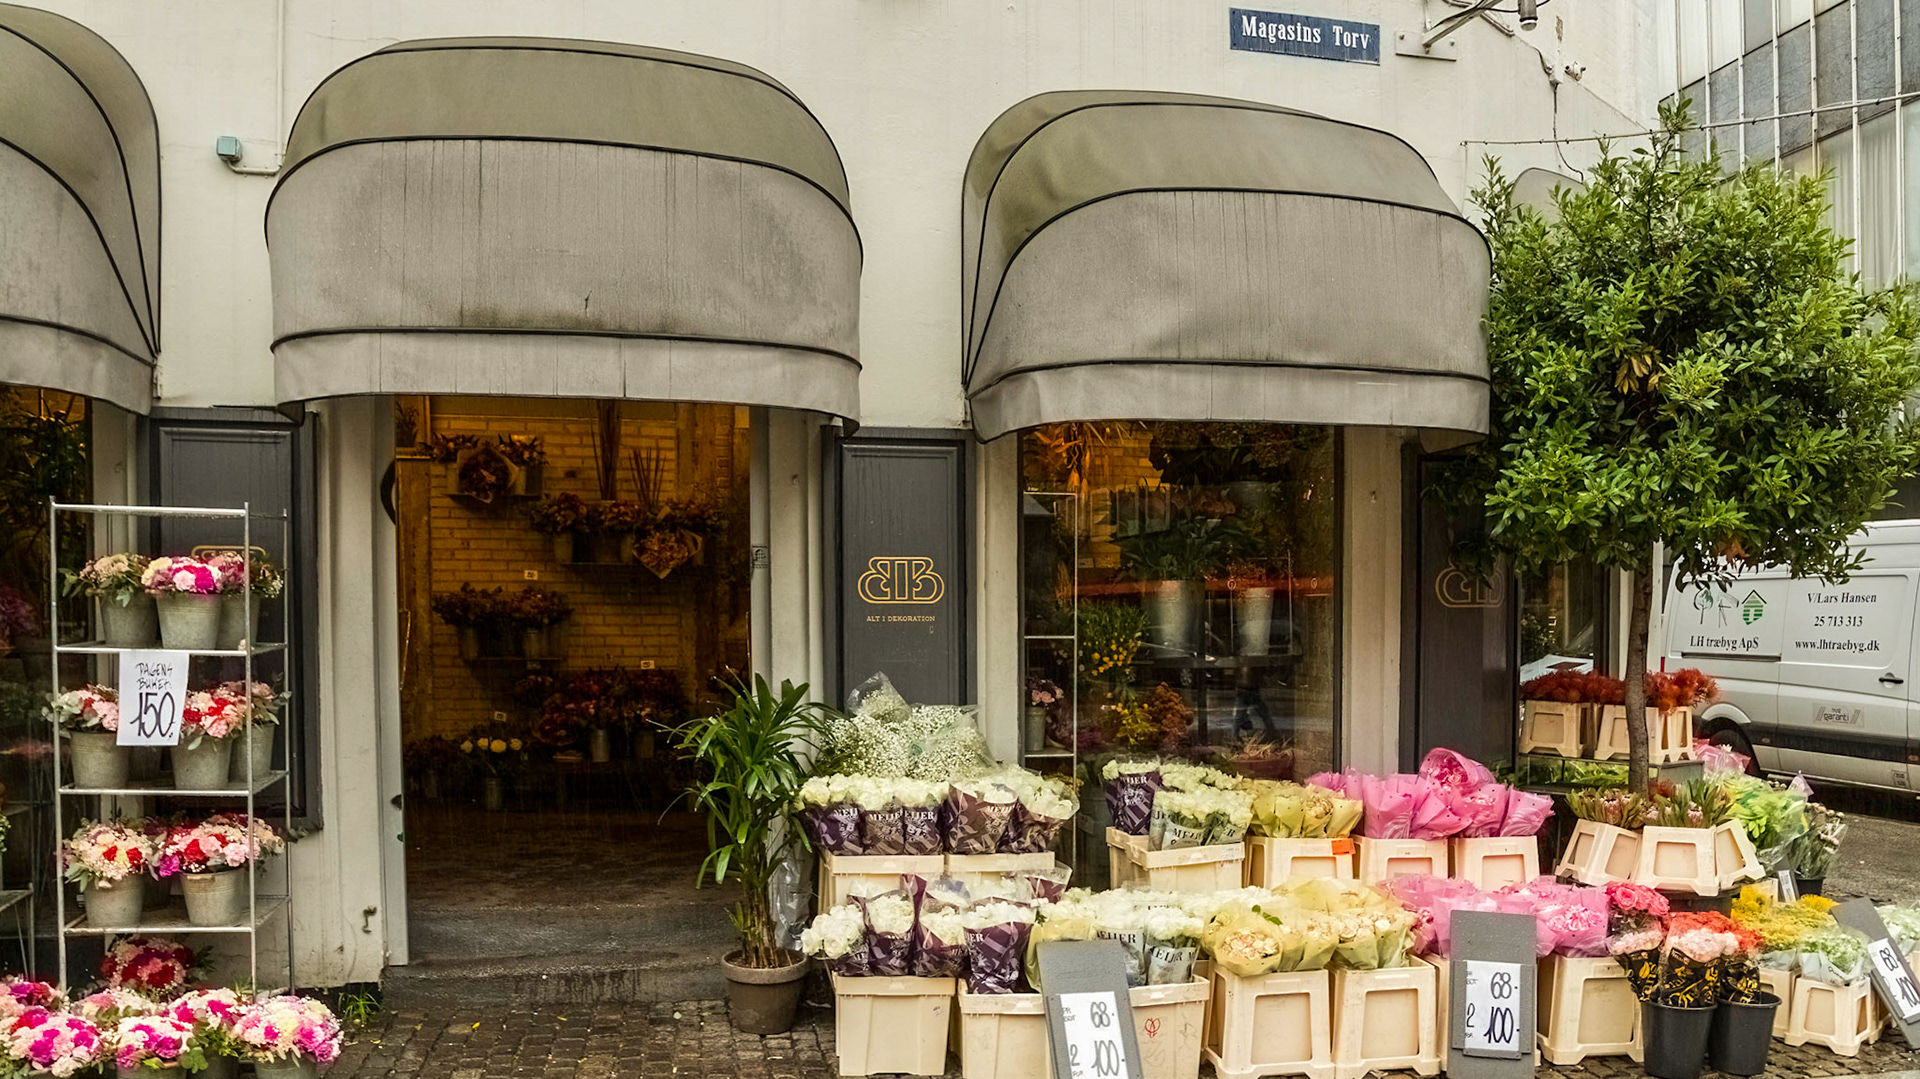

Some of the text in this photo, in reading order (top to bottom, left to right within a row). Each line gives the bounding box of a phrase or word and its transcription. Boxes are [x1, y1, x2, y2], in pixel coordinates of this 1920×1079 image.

[1241, 15, 1370, 49] Magasins Torv
[1807, 592, 1877, 604] V/Lars Hansen
[1814, 615, 1863, 627] 25 713 313
[1690, 635, 1759, 652] LH træbyg ApS
[1795, 639, 1880, 654] www.lhtraebyg.dk
[1466, 1002, 1476, 1028] 2
[1069, 1043, 1081, 1067] 2
